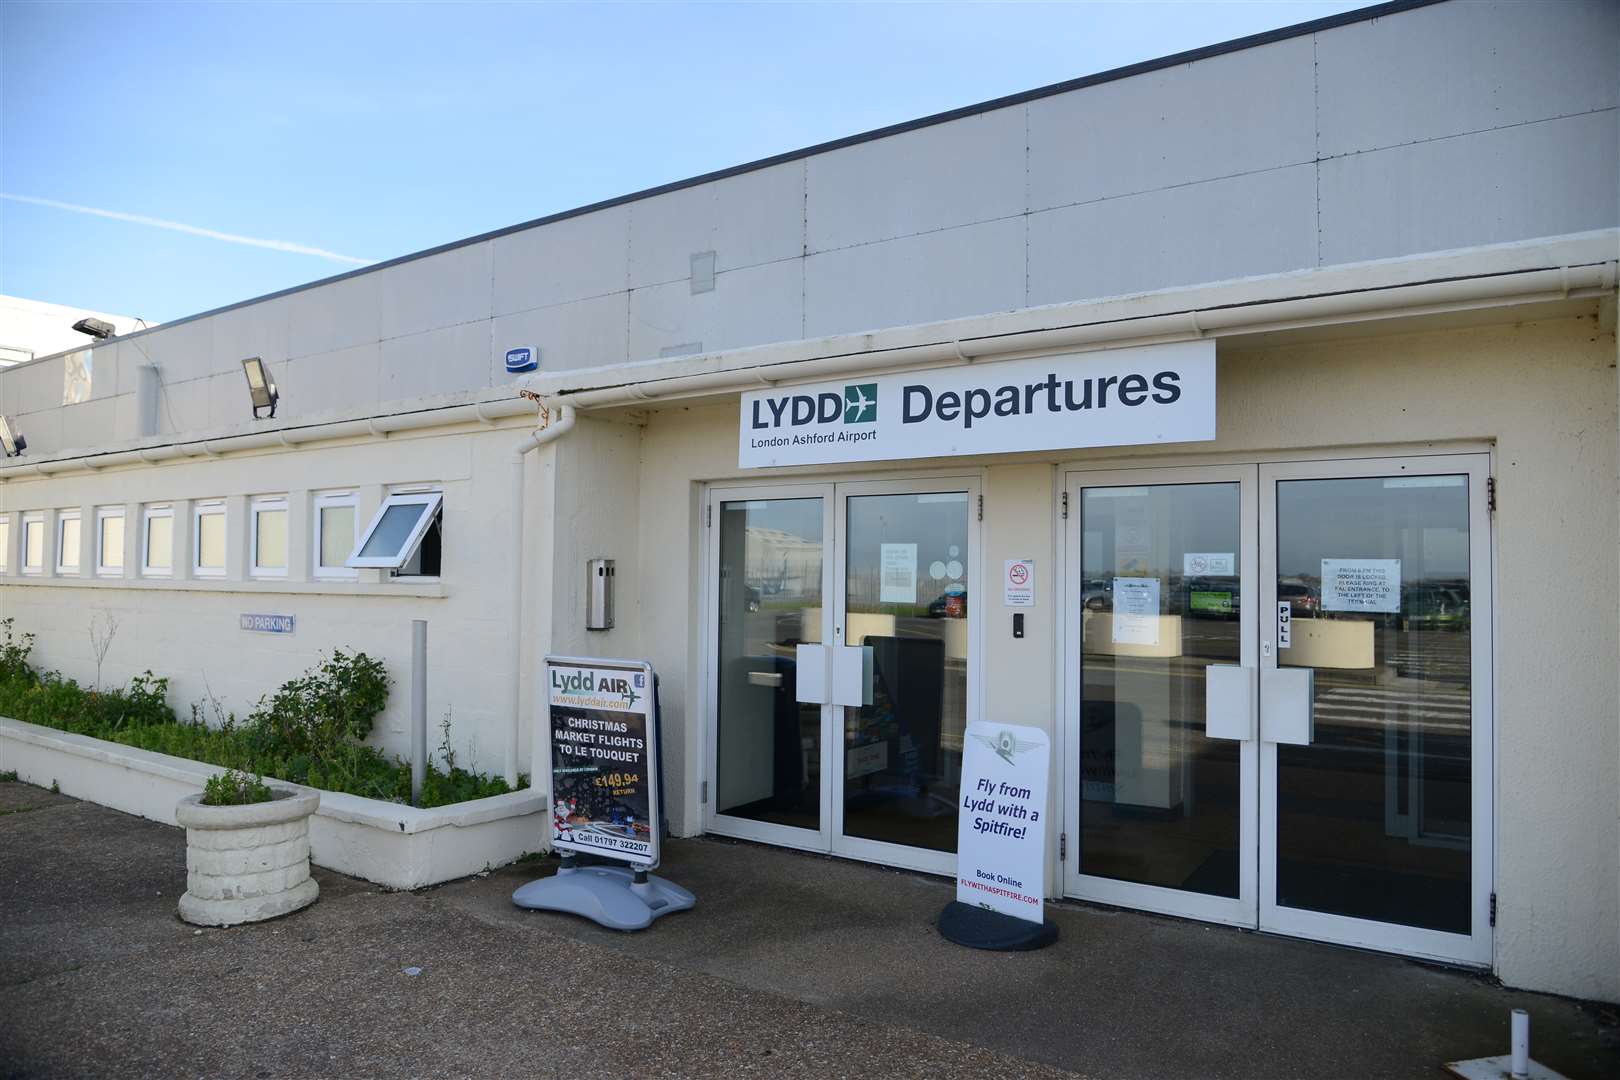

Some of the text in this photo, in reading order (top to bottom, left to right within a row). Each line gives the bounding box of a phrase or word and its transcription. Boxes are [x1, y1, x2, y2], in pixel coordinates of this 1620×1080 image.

[752, 370, 1182, 429] LYDD Departures
[751, 429, 877, 449] London Ashford Airport
[241, 616, 291, 631] NO PARKING
[1280, 606, 1289, 643] PULL
[552, 670, 628, 694] Lydd AIR
[552, 694, 629, 710] www.lyddair.com
[568, 717, 628, 733] CHRISTMAS
[555, 730, 643, 749] MARKET FLIGHTS
[559, 744, 640, 763] TO LE TOUQUET
[613, 788, 635, 796] RETURN
[976, 778, 1031, 800] Fly from
[963, 795, 1040, 822] Lydd with a
[973, 817, 1028, 840] Spitfire!
[578, 833, 648, 853] Call 01797 322207
[976, 869, 1024, 889] Book Online
[960, 878, 1040, 905] FLYWITHASPITFIRE.COM
